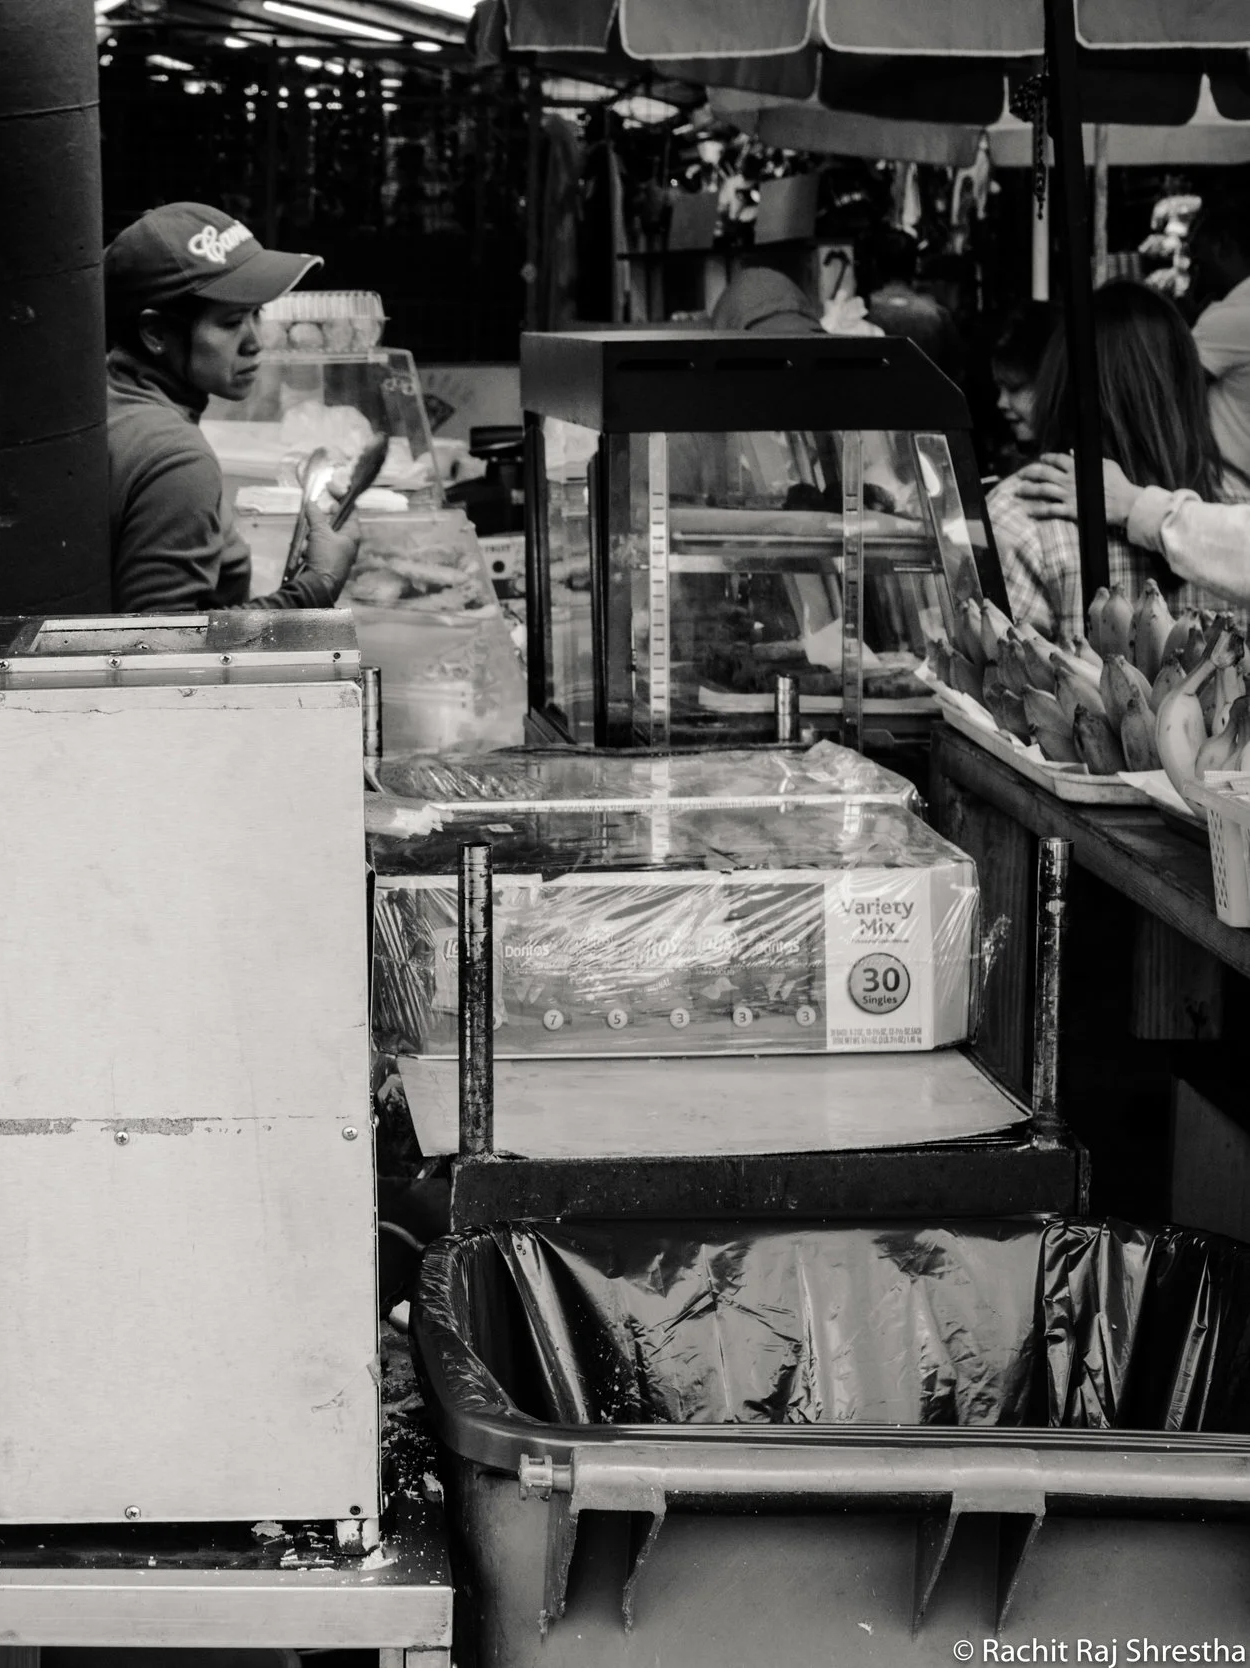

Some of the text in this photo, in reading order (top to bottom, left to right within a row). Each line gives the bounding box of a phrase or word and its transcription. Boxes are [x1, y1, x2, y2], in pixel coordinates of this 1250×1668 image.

[841, 897, 914, 920] Variety
[860, 918, 895, 935] Mix
[505, 944, 550, 958] Doritos
[862, 967, 900, 992] 30
[862, 995, 897, 1007] Singles
[550, 1015, 558, 1026] 7
[613, 1014, 621, 1025] 5
[676, 1012, 684, 1024] 3
[738, 1012, 747, 1023] 3
[802, 1011, 810, 1022] 3
